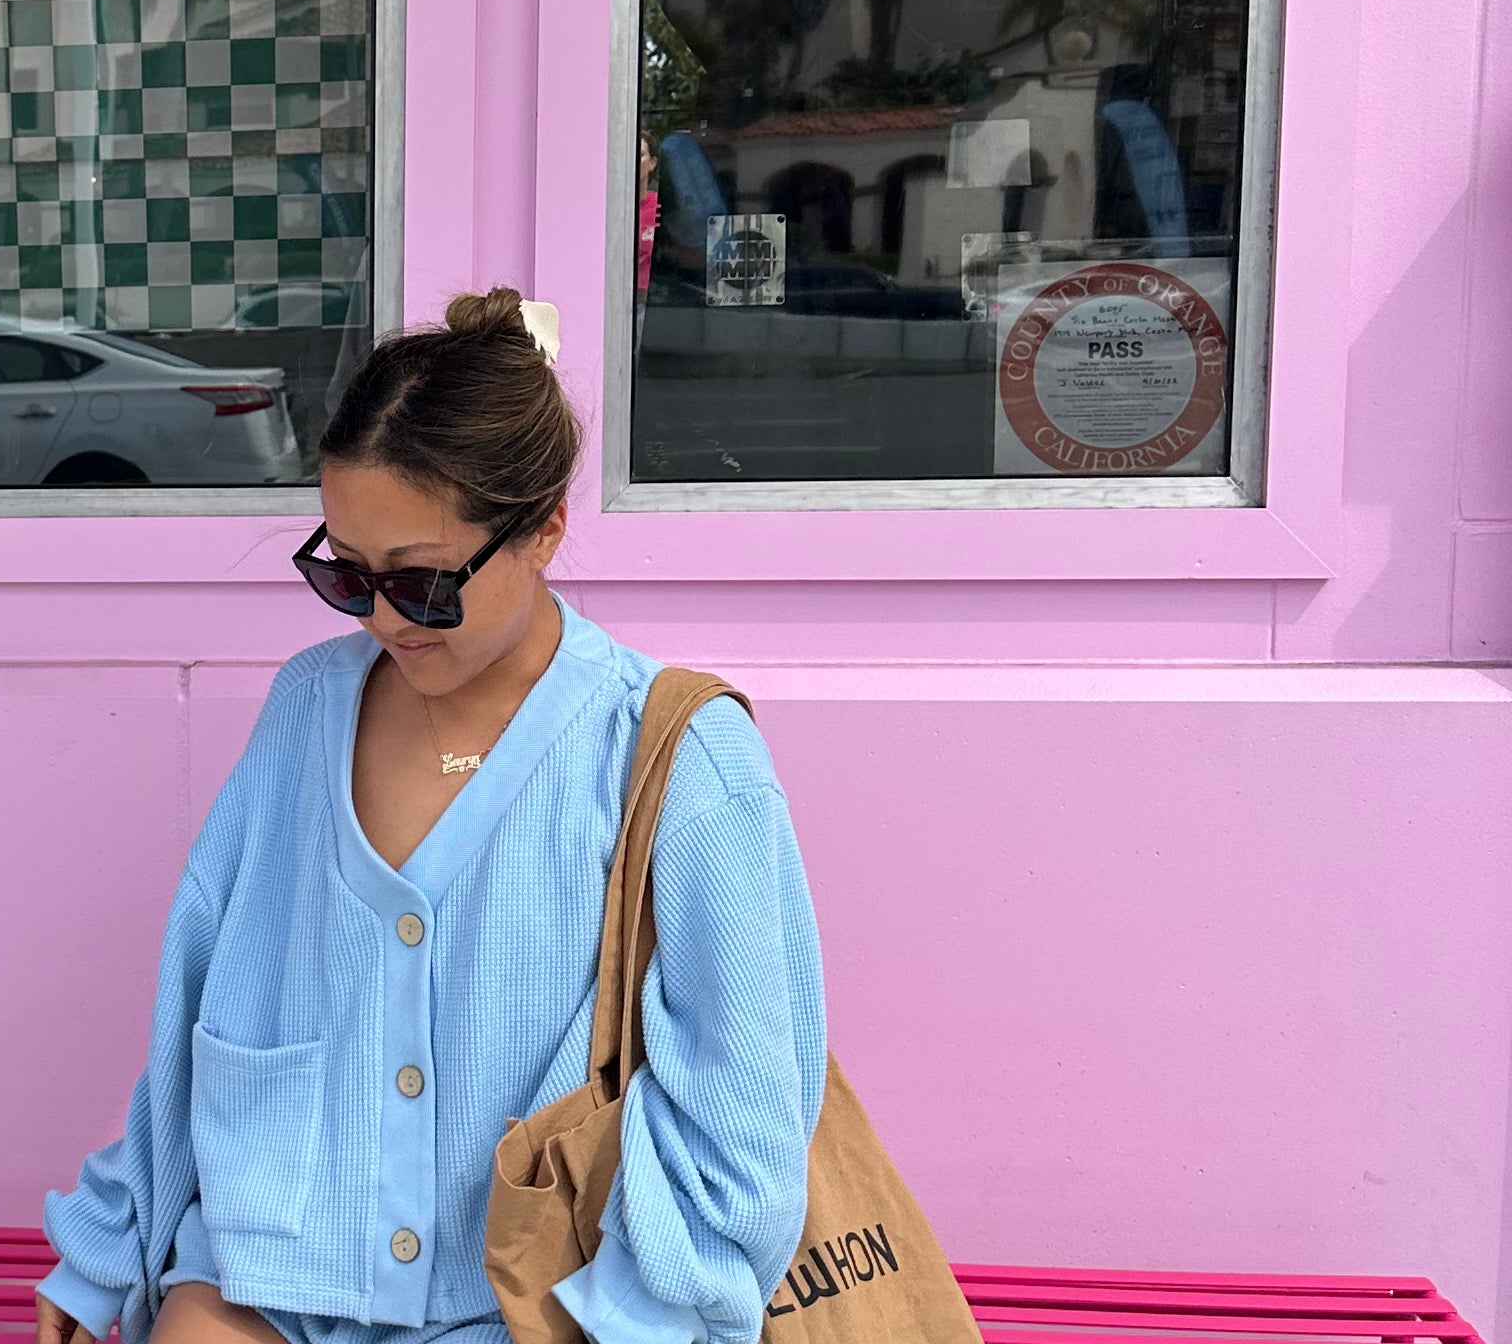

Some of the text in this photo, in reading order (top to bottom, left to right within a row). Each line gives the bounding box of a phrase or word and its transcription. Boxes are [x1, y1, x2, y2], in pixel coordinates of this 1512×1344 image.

[1006, 274, 1223, 381] COUNTY OF ORANGE
[1088, 341, 1144, 359] PASS
[1034, 425, 1197, 472] CALIFORNIA
